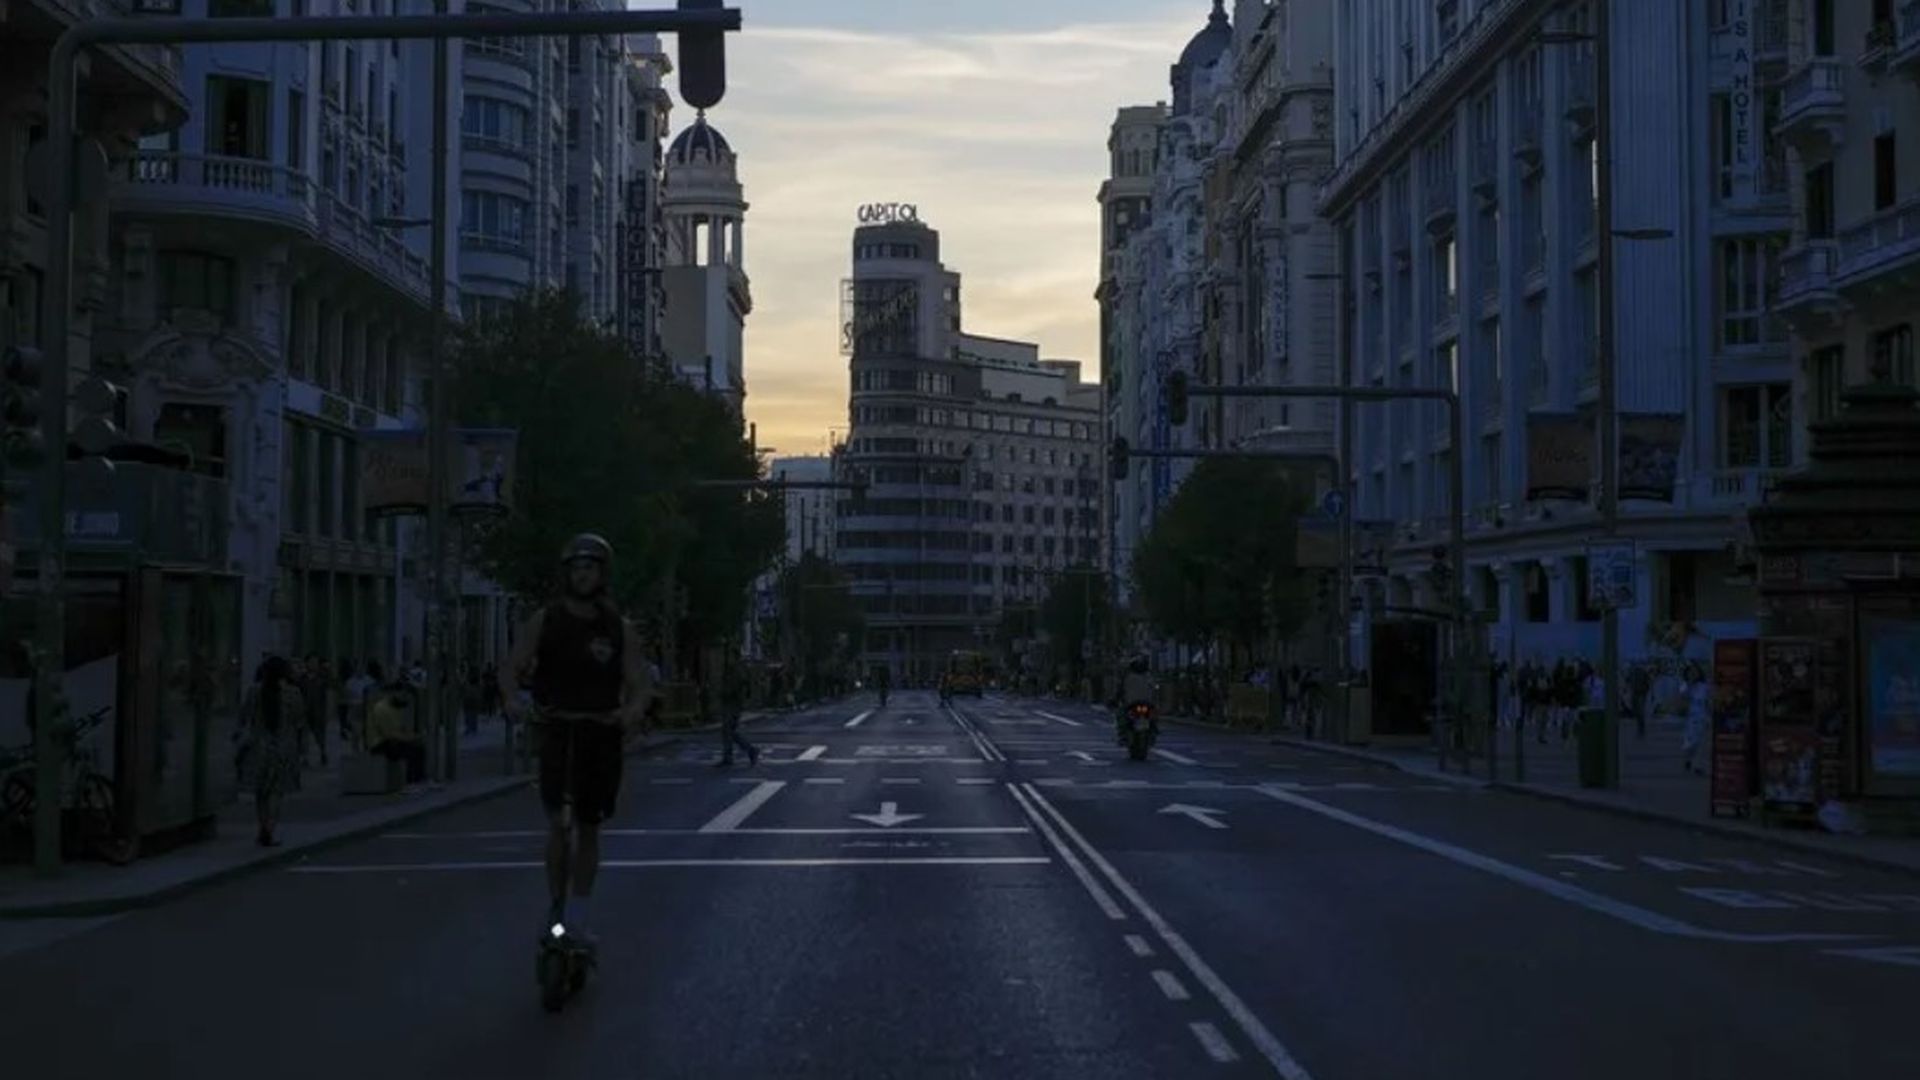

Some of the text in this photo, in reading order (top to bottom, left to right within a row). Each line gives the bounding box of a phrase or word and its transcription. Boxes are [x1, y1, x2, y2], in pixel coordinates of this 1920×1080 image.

[1734, 49, 1748, 62] A
[1735, 75, 1748, 163] HOTEL
[857, 202, 917, 222] CAPITOL
[629, 211, 645, 300] HOTEL
